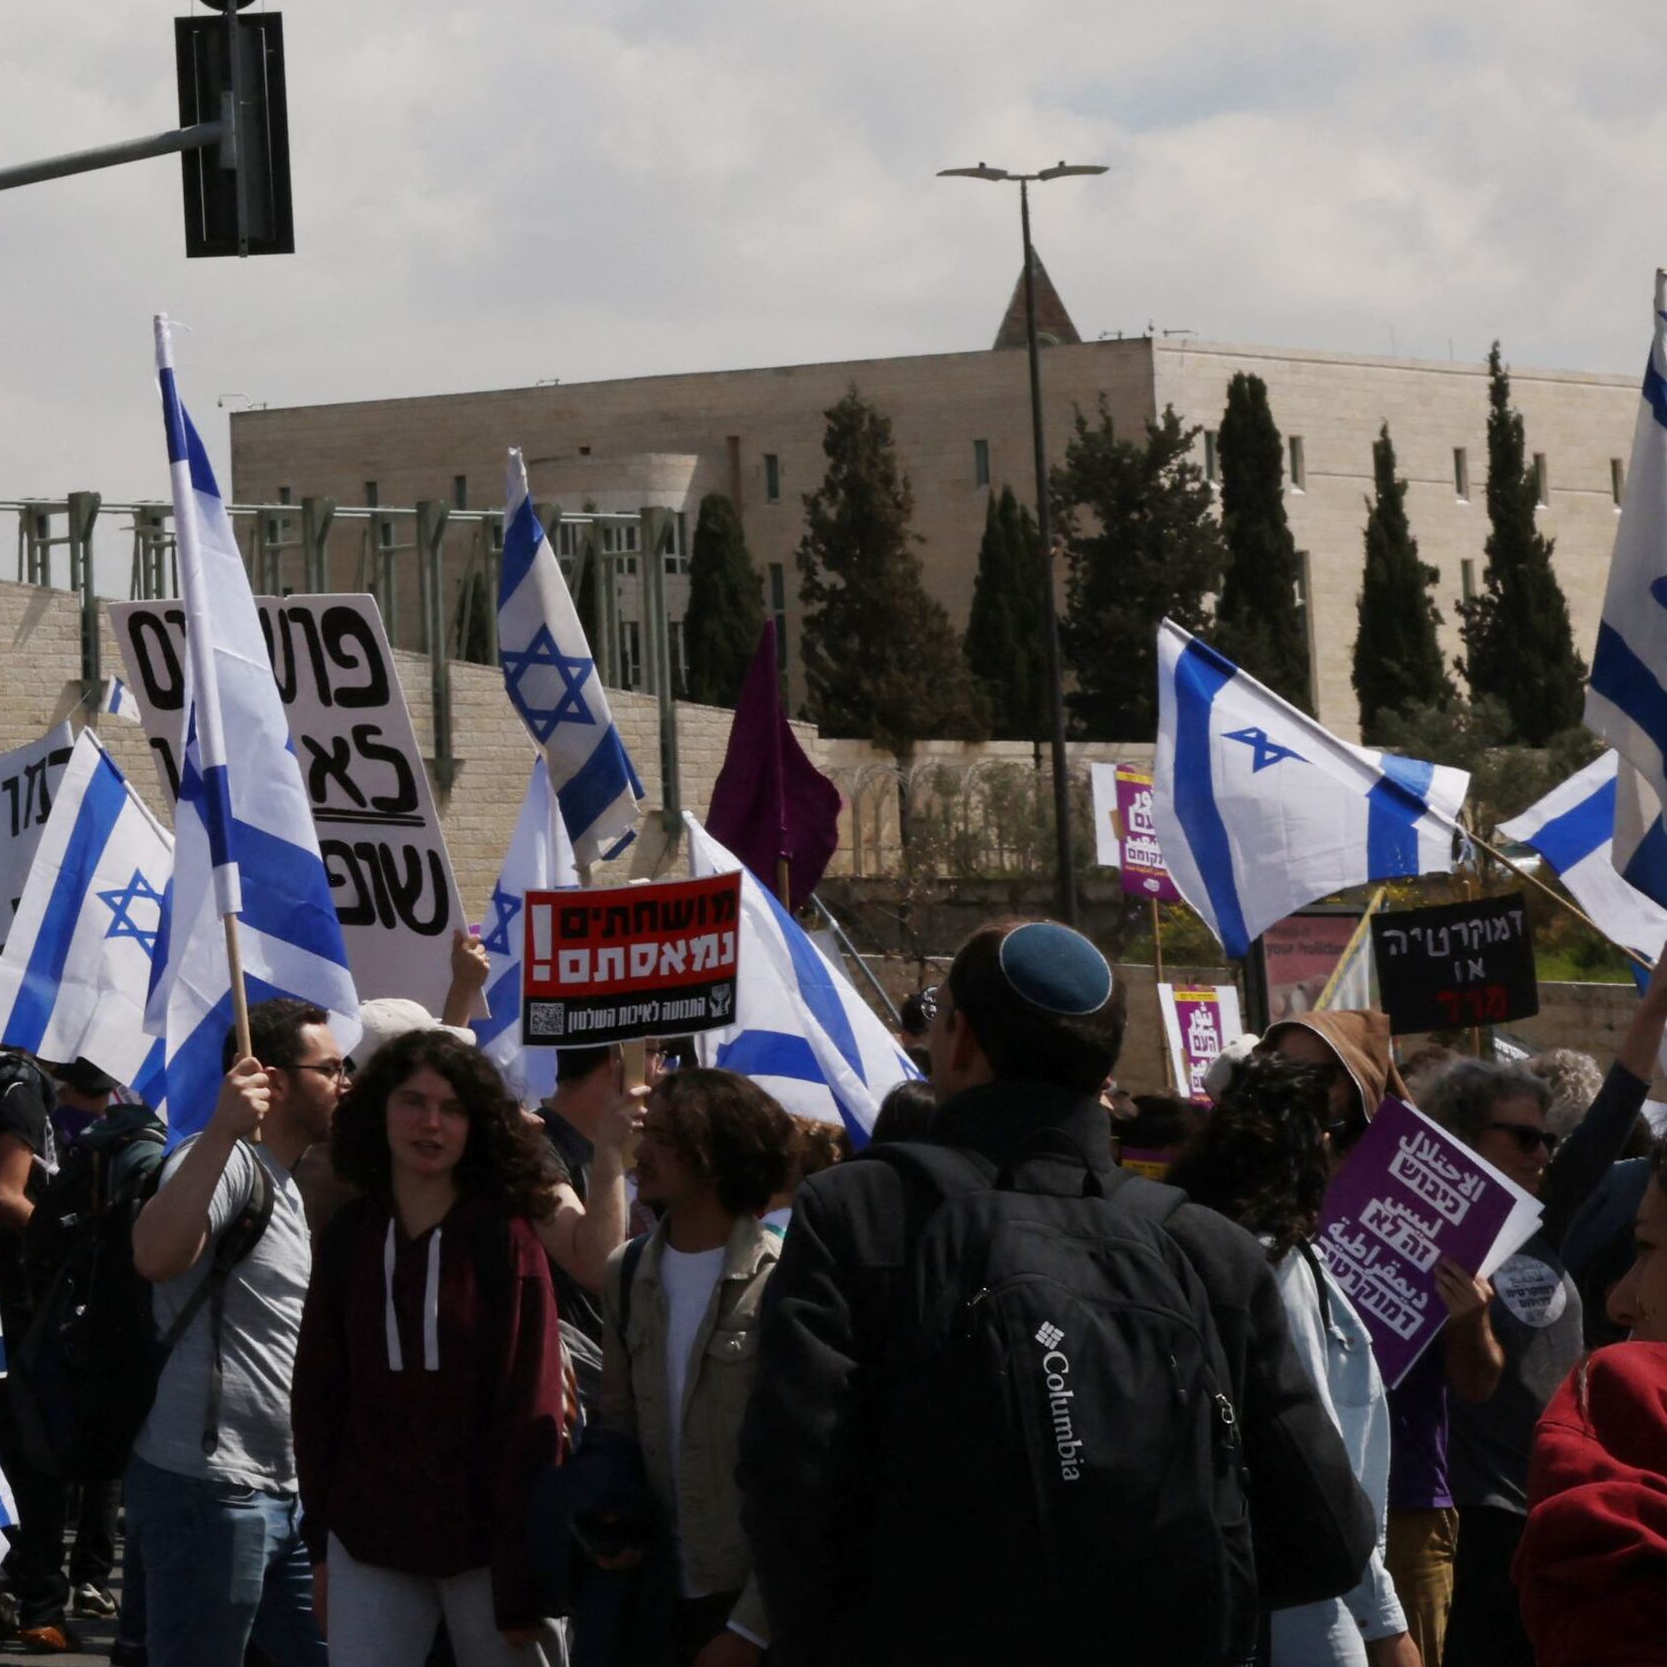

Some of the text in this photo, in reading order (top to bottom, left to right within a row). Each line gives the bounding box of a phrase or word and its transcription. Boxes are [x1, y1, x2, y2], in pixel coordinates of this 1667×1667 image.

[300, 723, 420, 814] לא
[560, 889, 736, 940] מושחתים
[1382, 910, 1522, 957] דמוקרטיה
[1454, 956, 1487, 983] או
[568, 996, 706, 1033] התנועה לאיכות השלטון
[1435, 986, 1509, 1024] מרד
[1193, 1034, 1218, 1053] העם
[1398, 1155, 1462, 1216] כיבוש
[1399, 1130, 1486, 1204] الاحتلال
[1368, 1207, 1432, 1263] זה לא
[1383, 1196, 1443, 1241] ليس
[1043, 1351, 1085, 1481] Columbia
